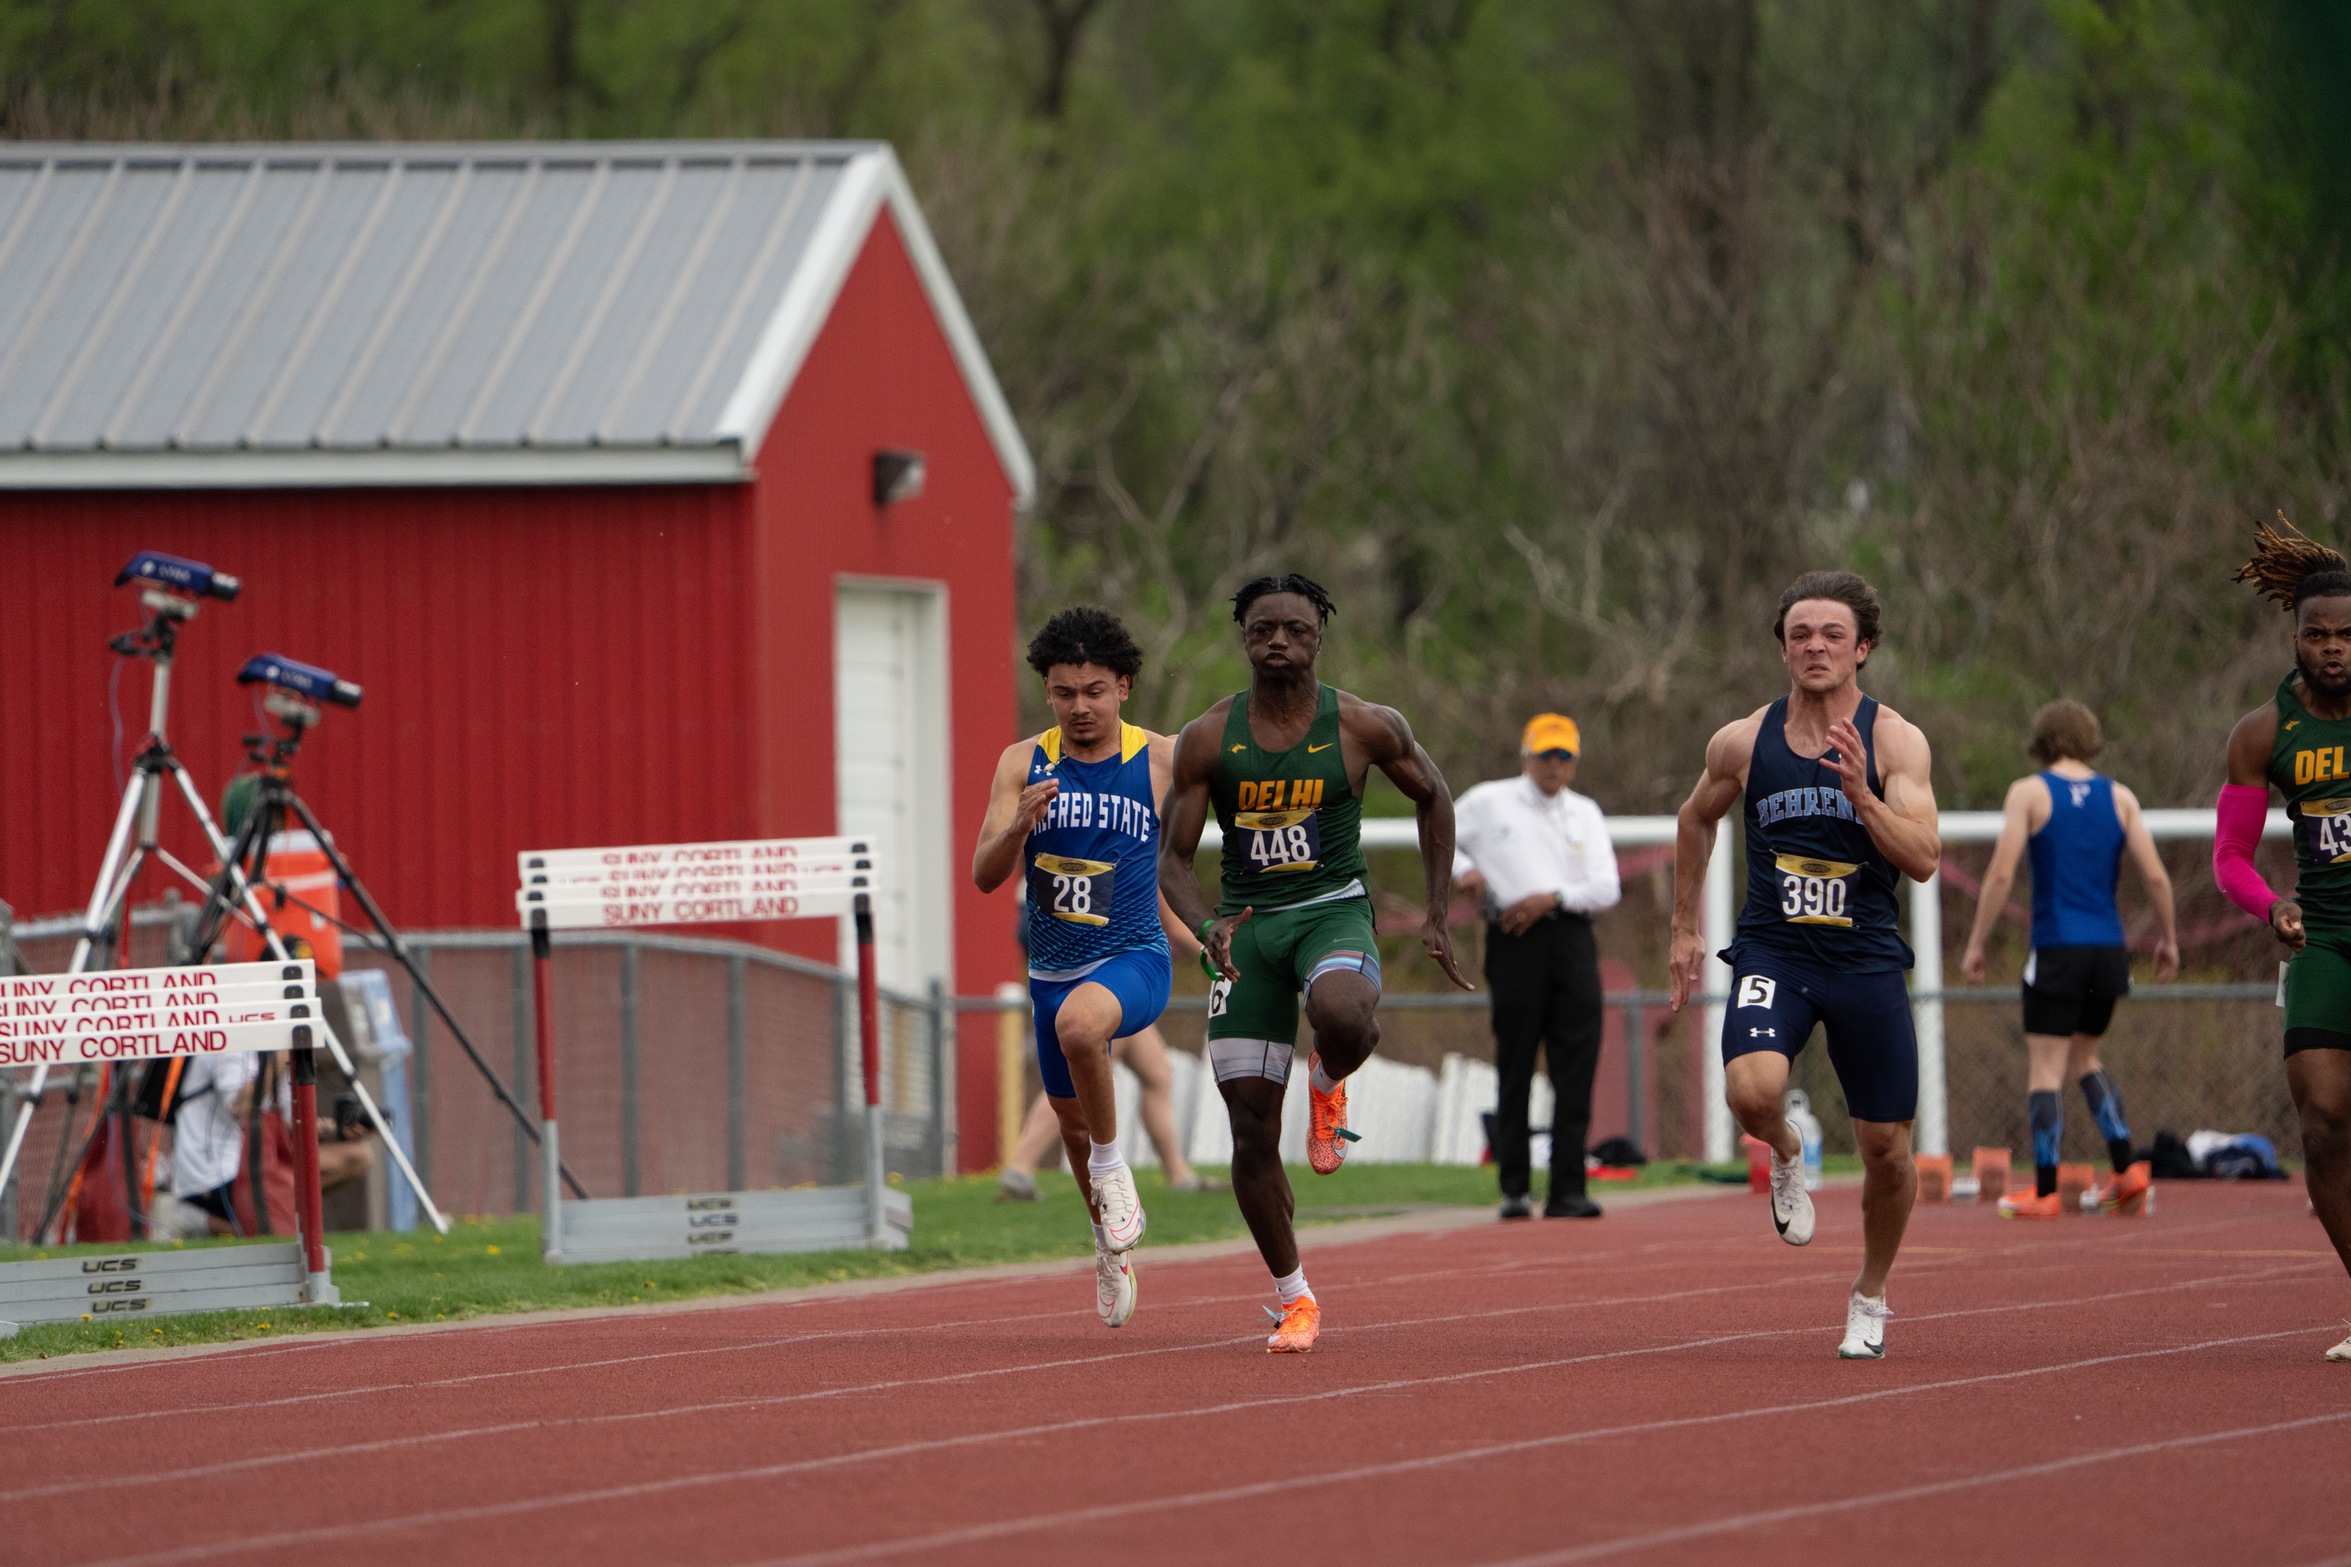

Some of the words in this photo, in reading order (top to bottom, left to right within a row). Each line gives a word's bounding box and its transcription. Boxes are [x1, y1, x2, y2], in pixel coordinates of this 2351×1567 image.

[1238, 779, 1324, 811] DELHI
[1756, 786, 1865, 828] BEHREN
[1034, 792, 1092, 836] FRED
[1098, 793, 1150, 842] STATE
[1250, 825, 1311, 866] 448
[1053, 875, 1091, 914] 28
[1782, 875, 1846, 917] 390
[603, 901, 663, 924] SUNY
[674, 896, 799, 921] CORTLAND
[1747, 977, 1770, 1004] 5
[0, 1000, 57, 1017] UNY
[0, 1039, 65, 1064] SUNY
[81, 1030, 227, 1058] CORTLAND
[689, 1213, 739, 1228] UCS
[83, 1258, 137, 1273] UCS
[88, 1280, 142, 1294] UCS
[93, 1299, 146, 1313] UCS
